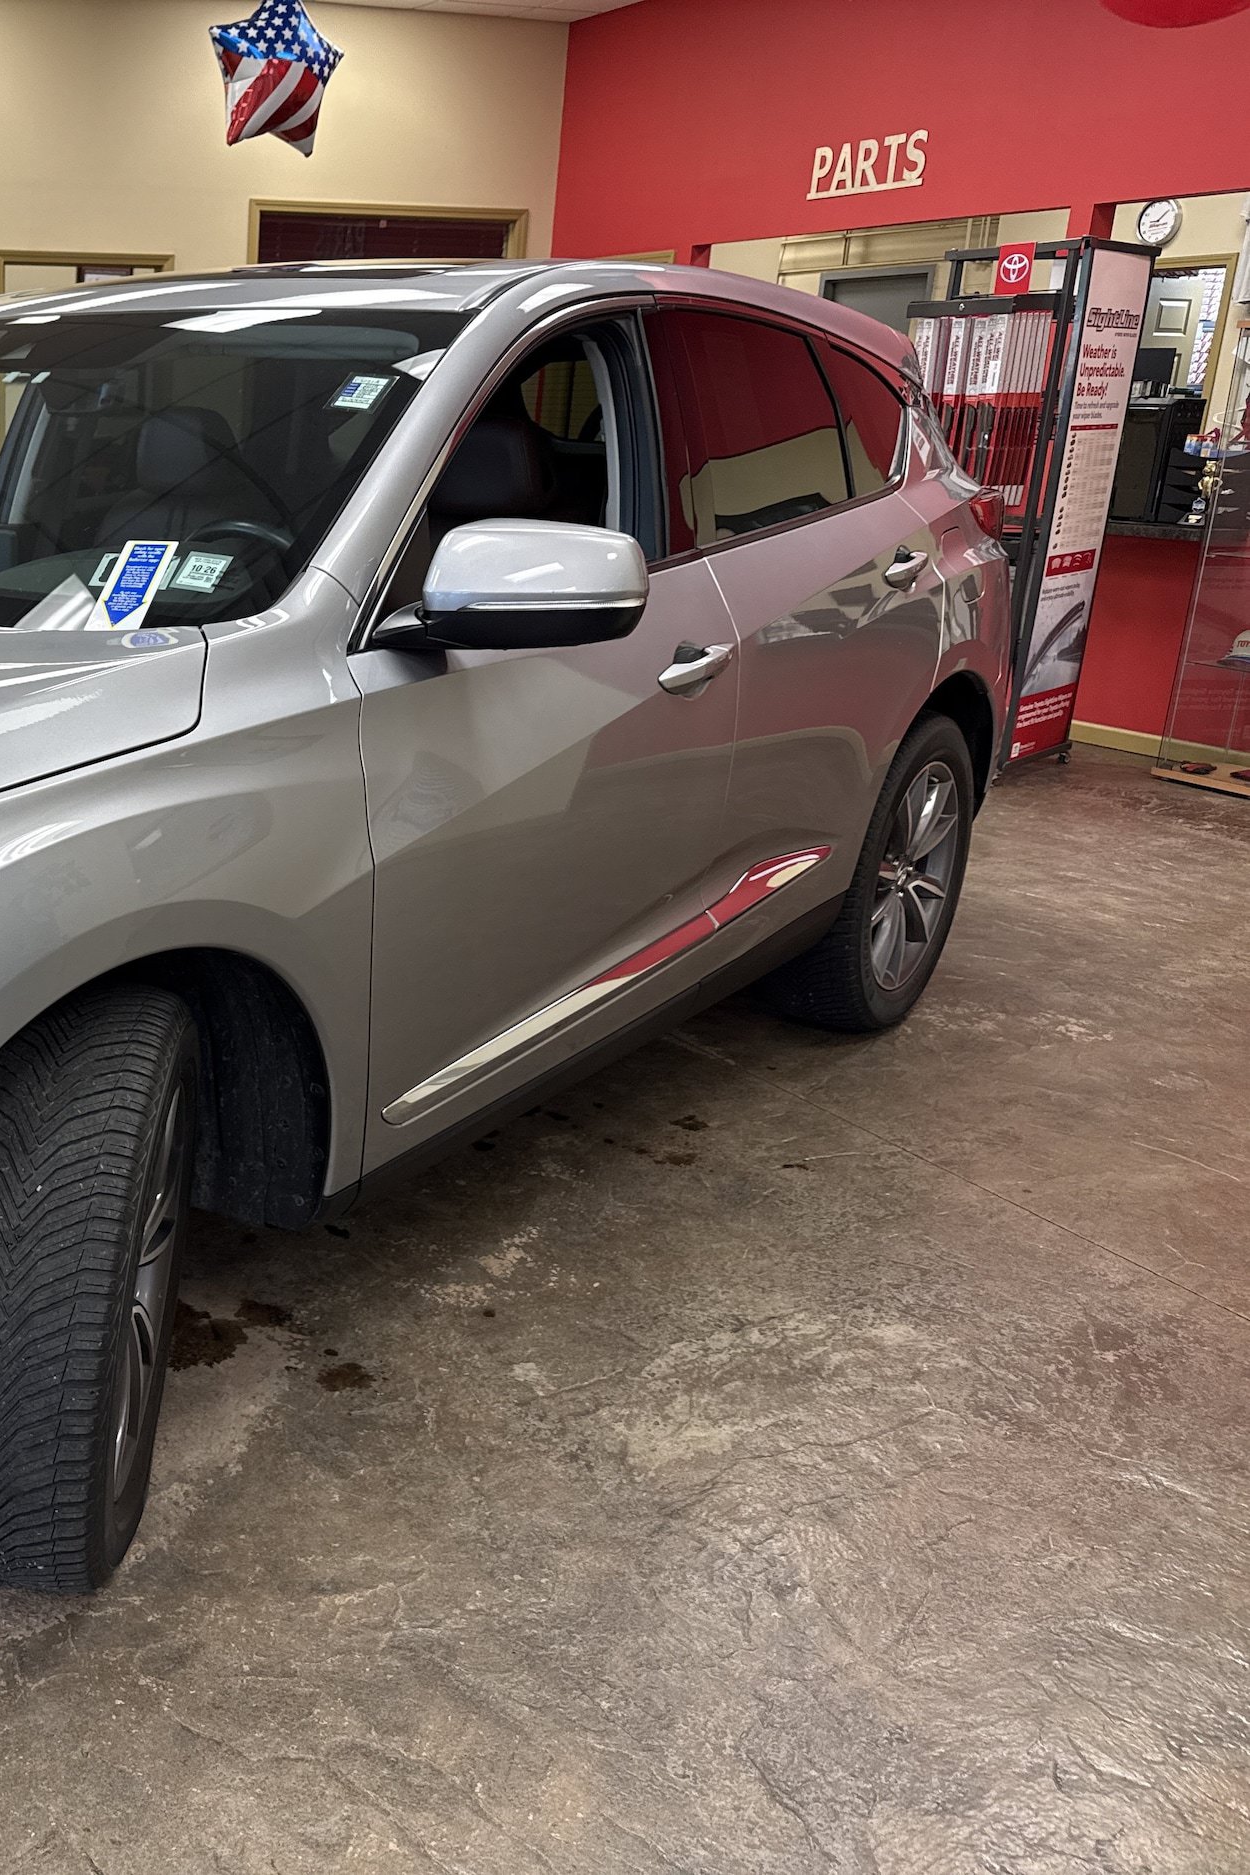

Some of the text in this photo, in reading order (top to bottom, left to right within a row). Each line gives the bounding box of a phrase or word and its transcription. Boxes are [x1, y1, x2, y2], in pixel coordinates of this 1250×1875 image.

[809, 129, 929, 195] PARTS
[1086, 307, 1140, 332] SightLine
[1083, 344, 1117, 359] Weather is
[1080, 362, 1125, 380] Unpredictable.
[1076, 382, 1108, 400] Be Ready!
[191, 564, 218, 574] 10 26
